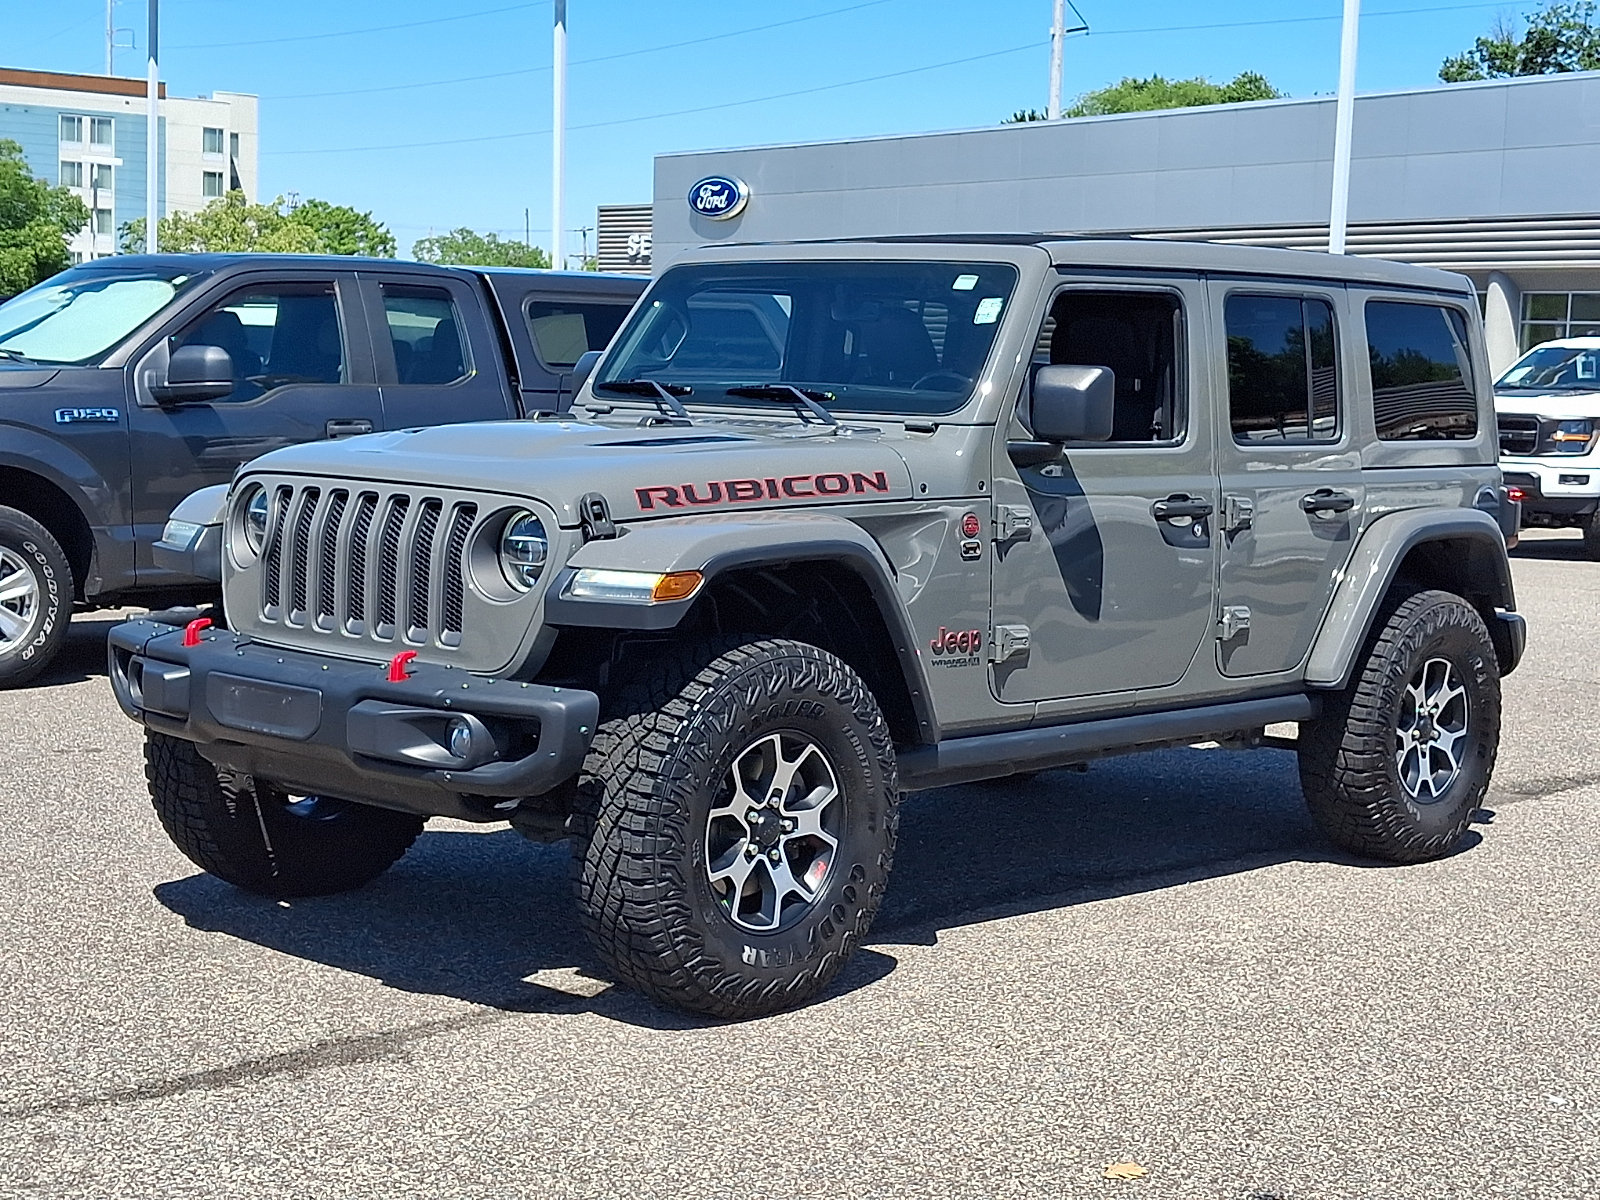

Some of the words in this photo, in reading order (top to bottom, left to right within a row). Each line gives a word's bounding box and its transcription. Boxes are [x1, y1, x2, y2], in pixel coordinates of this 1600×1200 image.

[697, 184, 729, 209] Ford
[635, 470, 889, 511] RUBICON
[22, 541, 59, 660] GOODYEAR
[930, 626, 981, 656] Jeep
